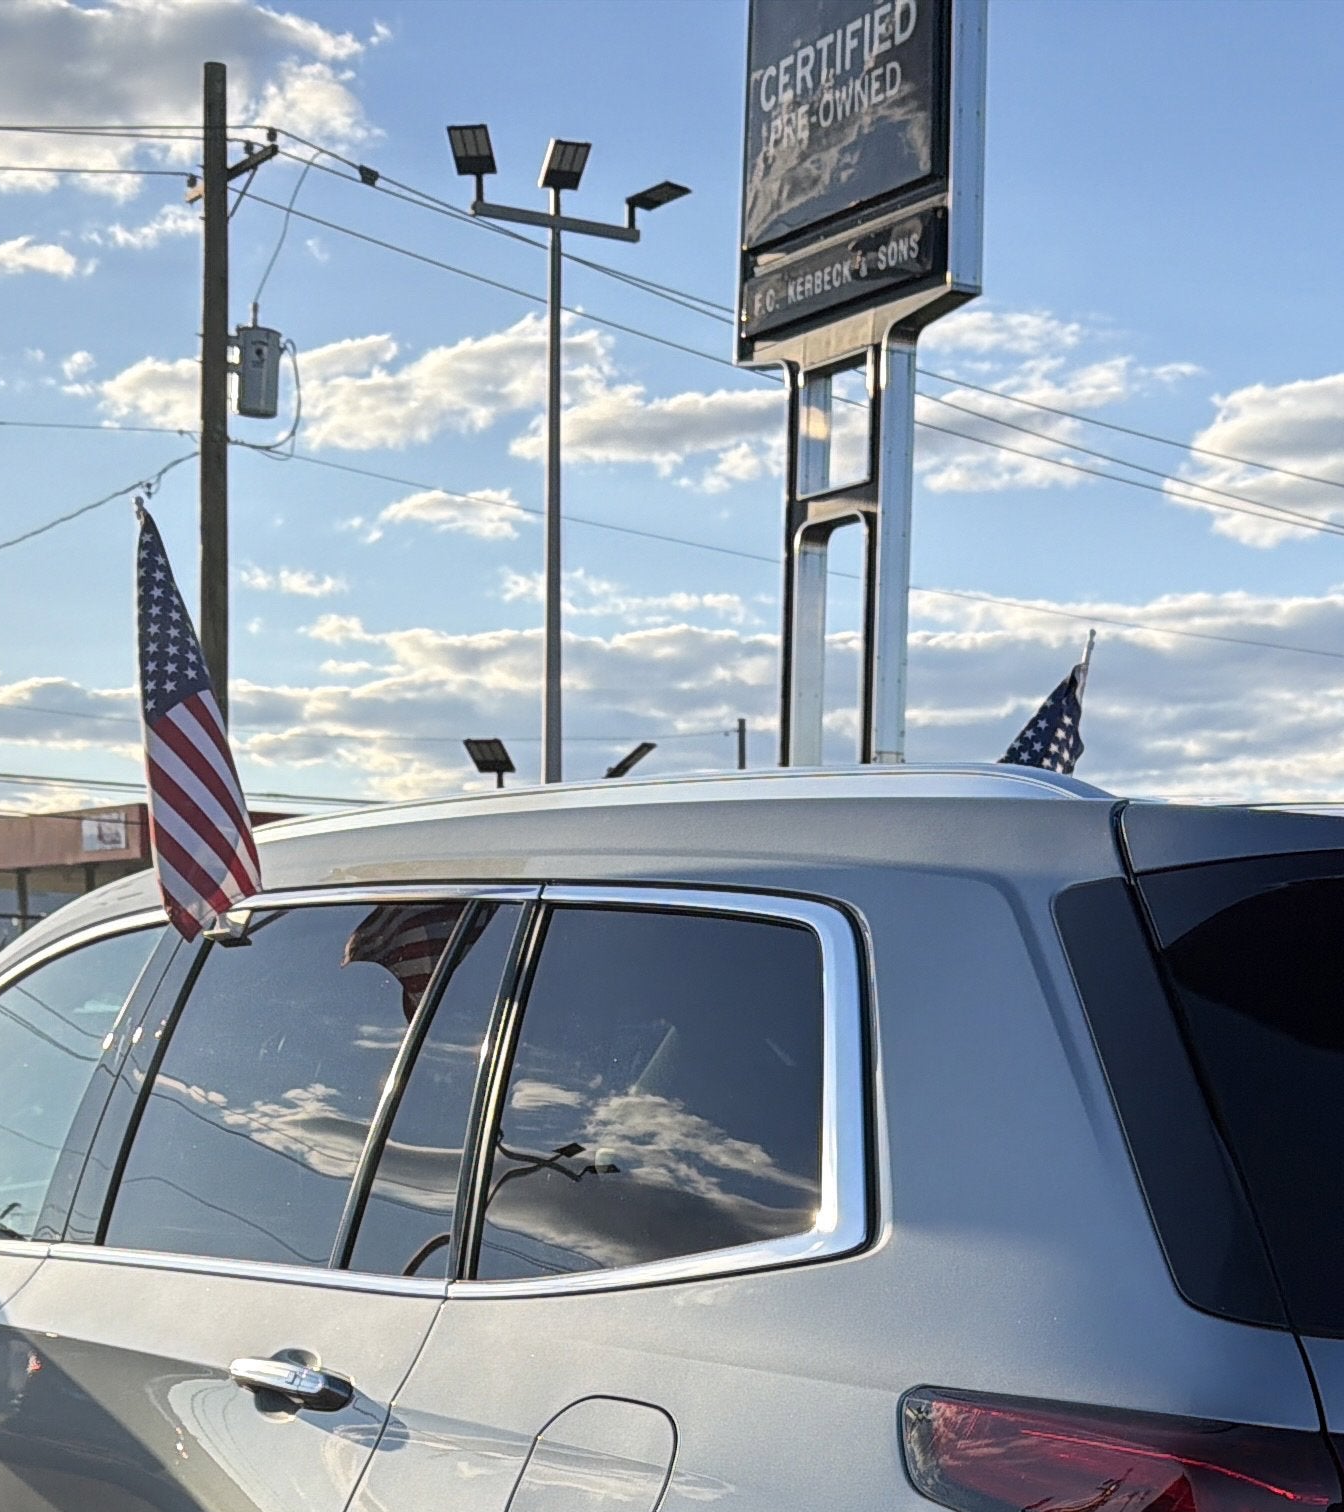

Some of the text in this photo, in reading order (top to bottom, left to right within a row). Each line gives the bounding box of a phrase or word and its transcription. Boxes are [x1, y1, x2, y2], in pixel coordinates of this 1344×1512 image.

[760, 0, 917, 112] CERTIFIED
[770, 61, 901, 151] PRE-OWNED
[787, 259, 852, 304] KERBECK
[877, 233, 919, 271] SONS
